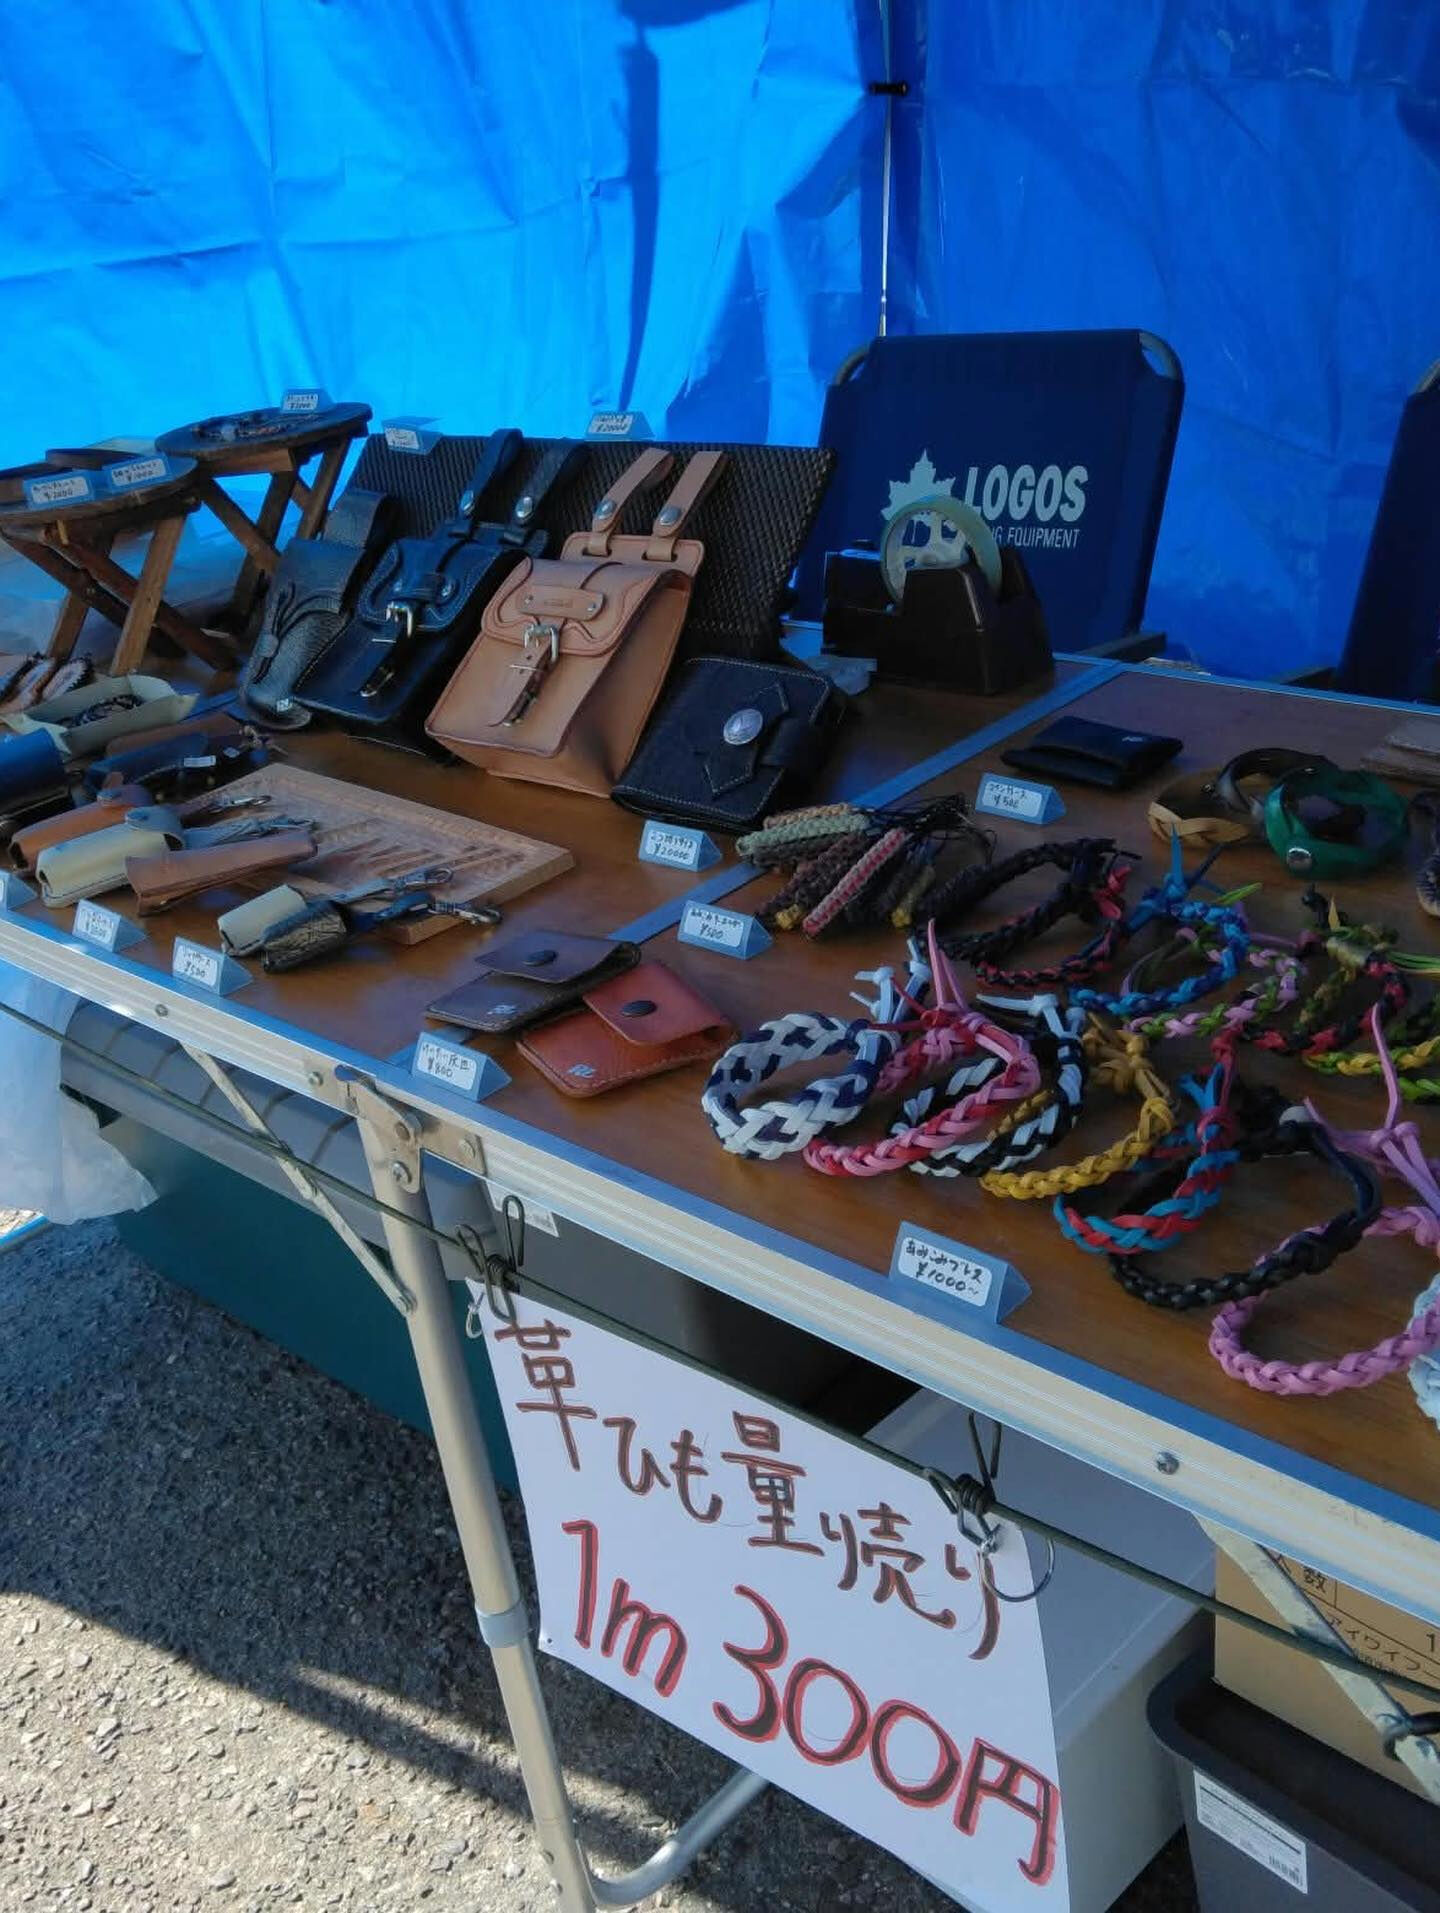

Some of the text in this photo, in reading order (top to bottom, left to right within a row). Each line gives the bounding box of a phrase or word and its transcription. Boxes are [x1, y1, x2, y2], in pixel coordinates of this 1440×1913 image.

[965, 464, 1089, 522] LOGOS
[1007, 527, 1080, 548] EQUIPMENT
[701, 922, 724, 940] ¥500
[494, 1317, 1000, 1661] 革ひも量り売り
[561, 1519, 688, 1698] 1m
[712, 1583, 1061, 1886] 300円
